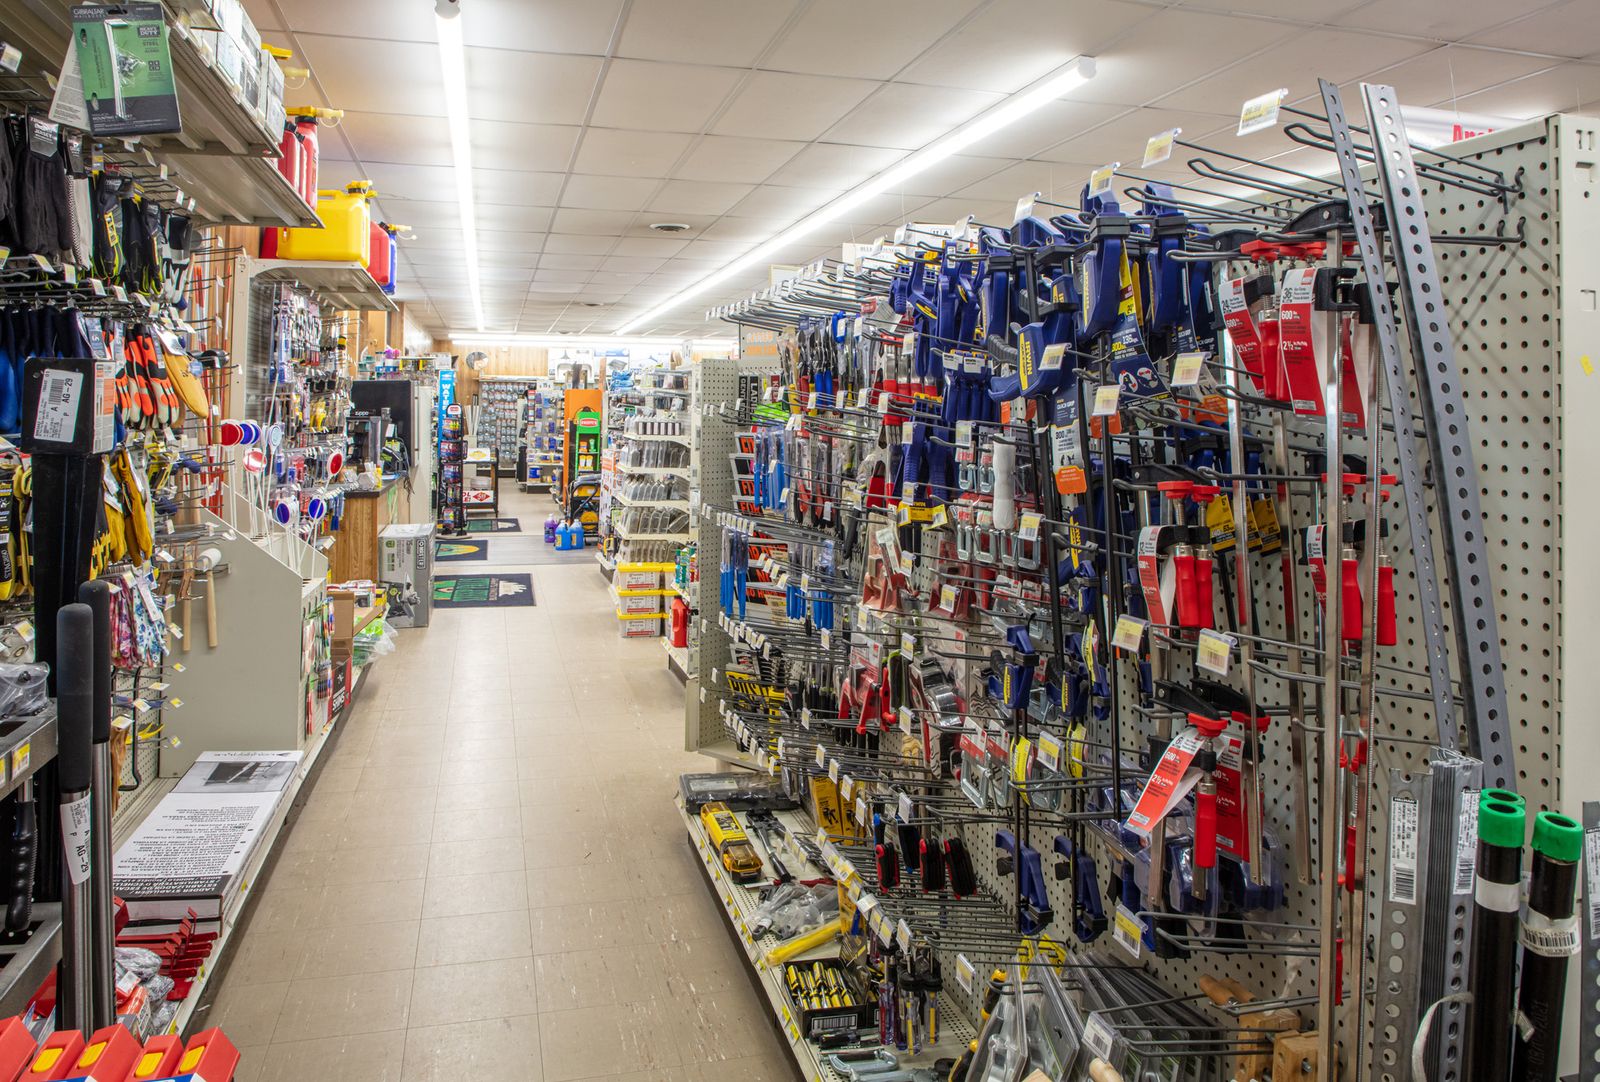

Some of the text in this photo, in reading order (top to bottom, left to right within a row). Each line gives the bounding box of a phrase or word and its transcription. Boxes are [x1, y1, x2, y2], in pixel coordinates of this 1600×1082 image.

[1281, 310, 1293, 320] 600
[1025, 340, 1033, 376] IRWIN
[62, 378, 73, 404] AG-29
[1164, 751, 1176, 761] 600
[76, 845, 89, 873] AG-29
